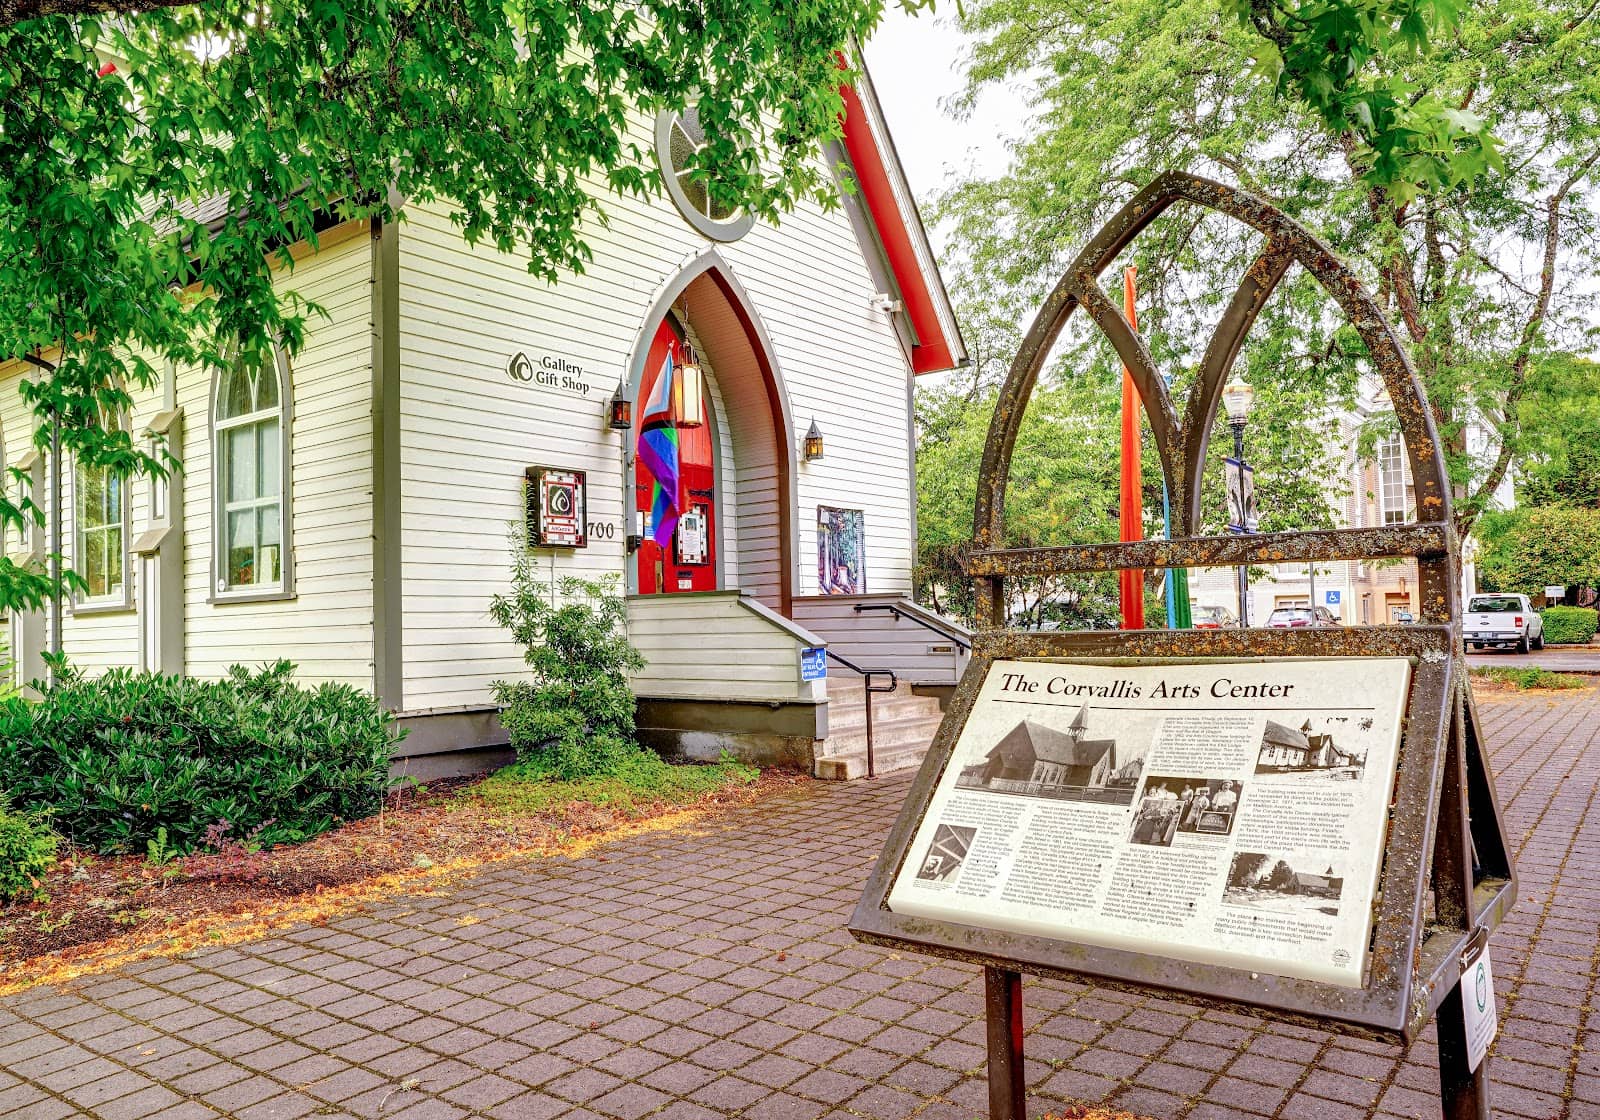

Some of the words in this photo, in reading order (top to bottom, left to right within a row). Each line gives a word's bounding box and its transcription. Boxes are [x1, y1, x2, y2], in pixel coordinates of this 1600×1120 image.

[542, 356, 582, 378] Gallery
[536, 372, 558, 386] Gift
[562, 376, 590, 394] Shop
[588, 522, 614, 539] 700
[1001, 673, 1039, 693] The
[1046, 677, 1142, 699] Corvallis
[1149, 679, 1201, 699] Arts
[1210, 678, 1295, 698] Center
